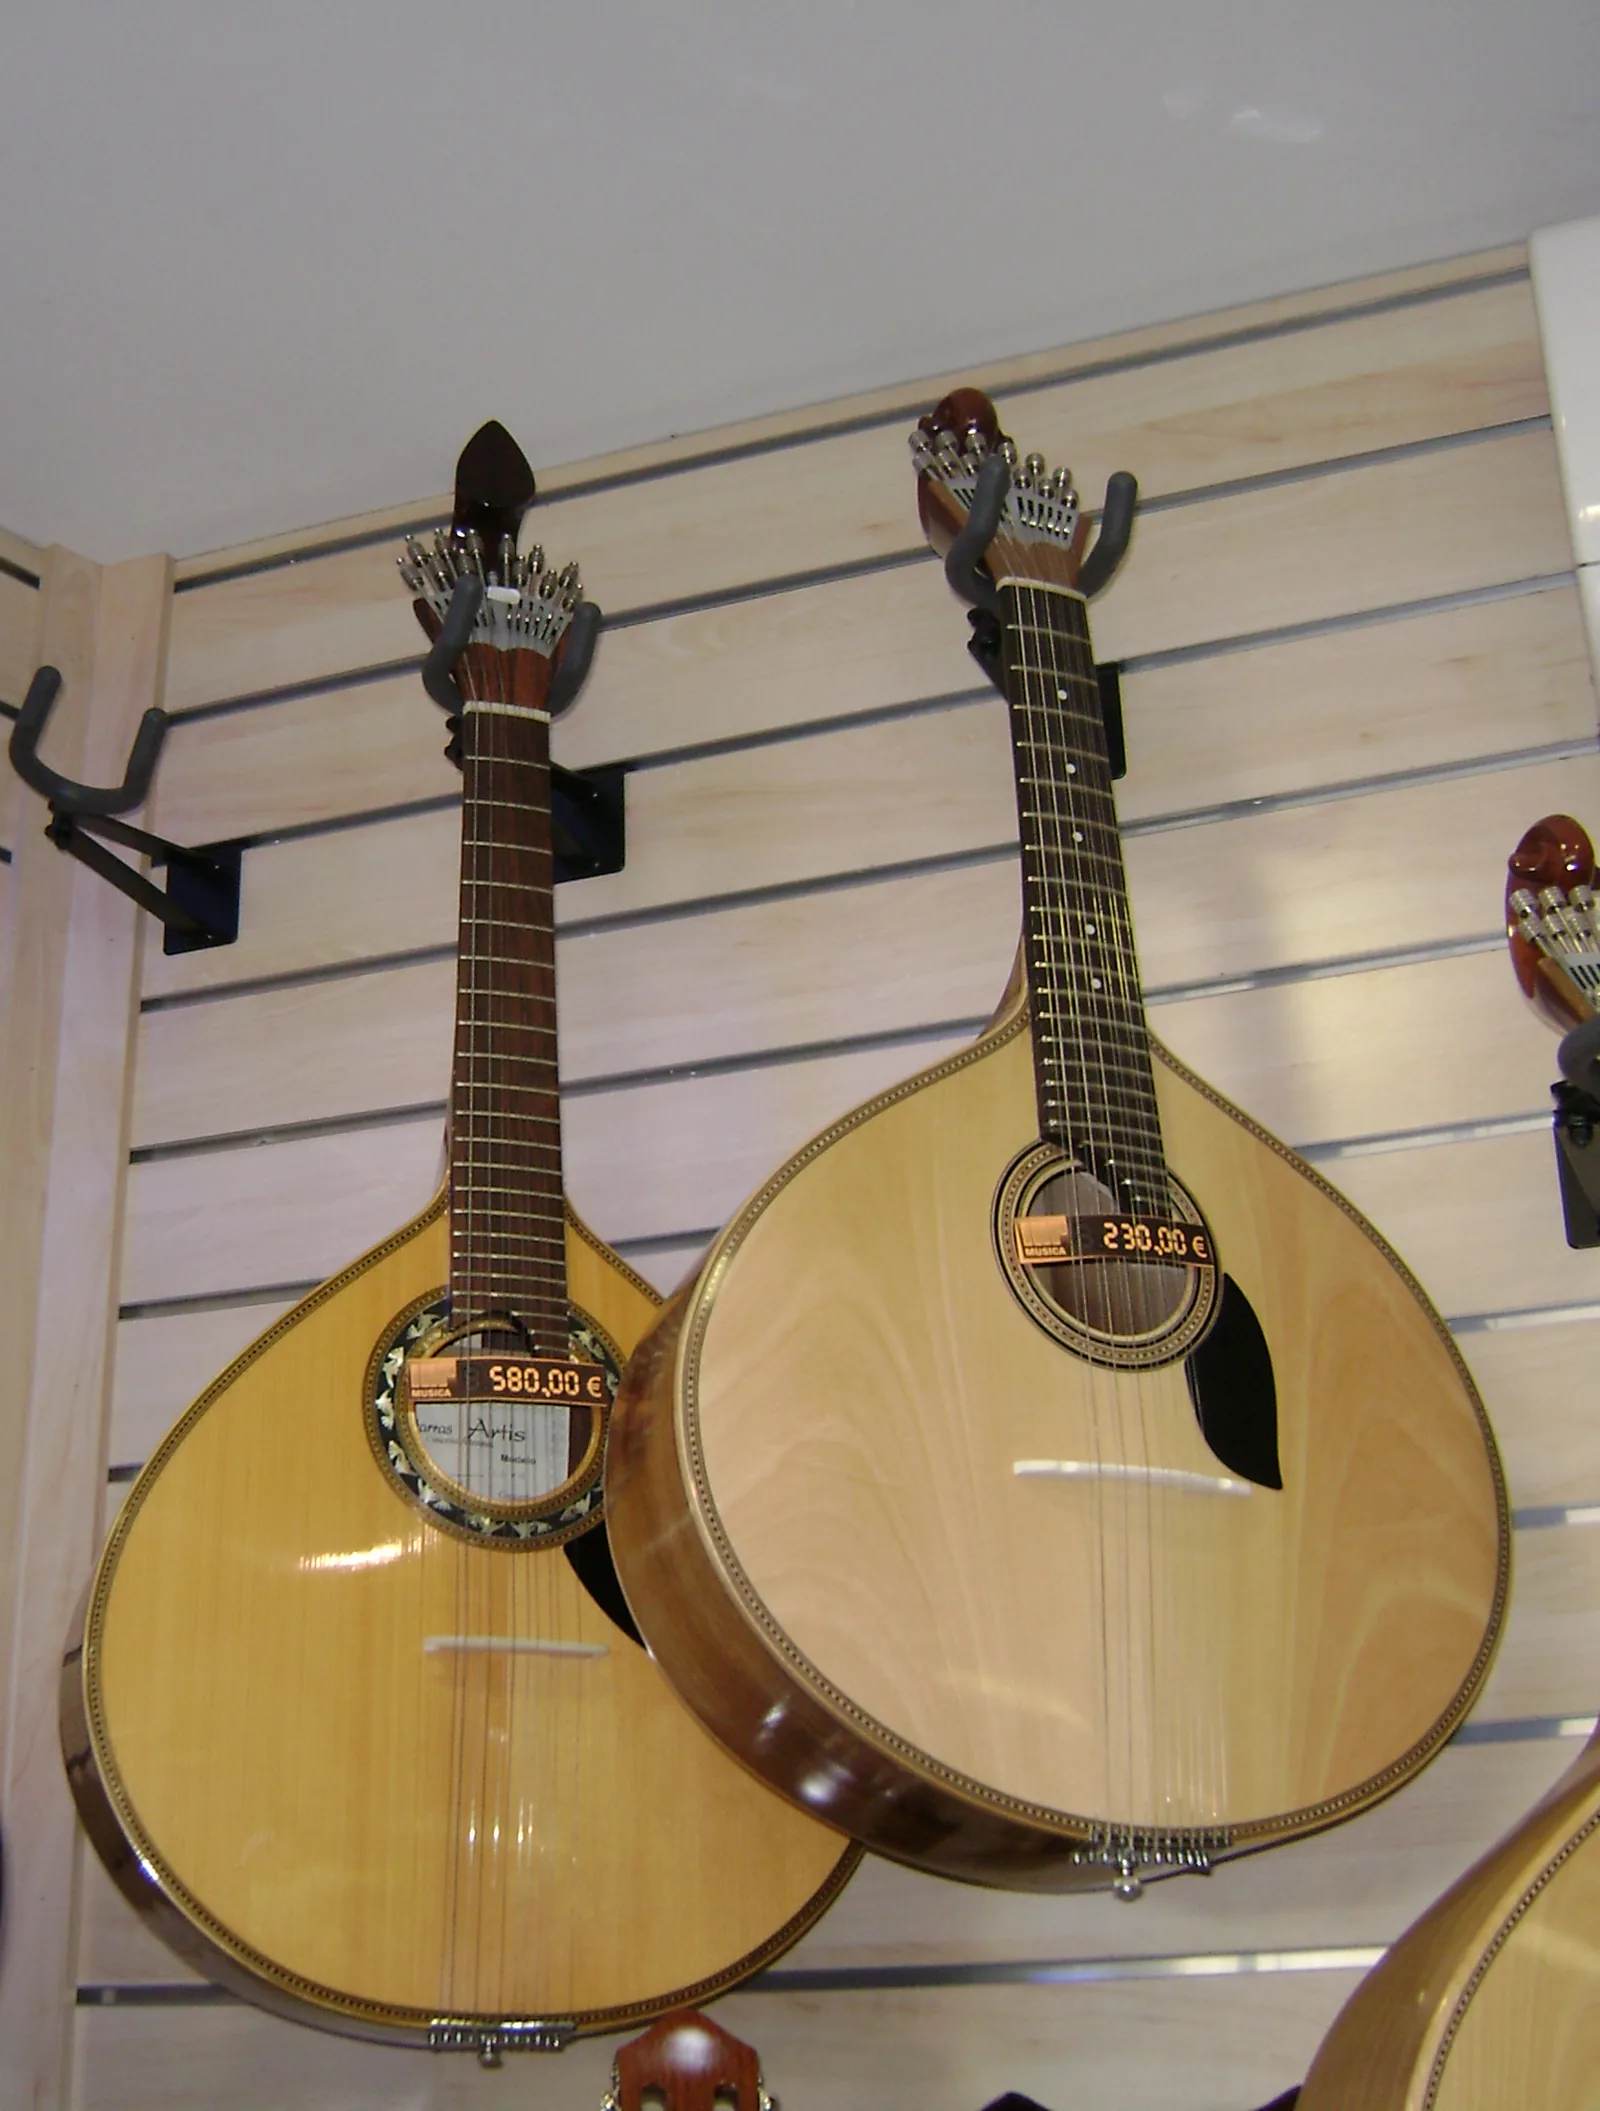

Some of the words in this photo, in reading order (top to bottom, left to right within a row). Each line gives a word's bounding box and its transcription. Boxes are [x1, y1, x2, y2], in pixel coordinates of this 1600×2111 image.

[1102, 1221, 1187, 1256] 230,00
[1192, 1235, 1208, 1259] €
[489, 1366, 579, 1397] 580,00
[586, 1376, 602, 1398] €
[467, 1418, 526, 1442] Artis
